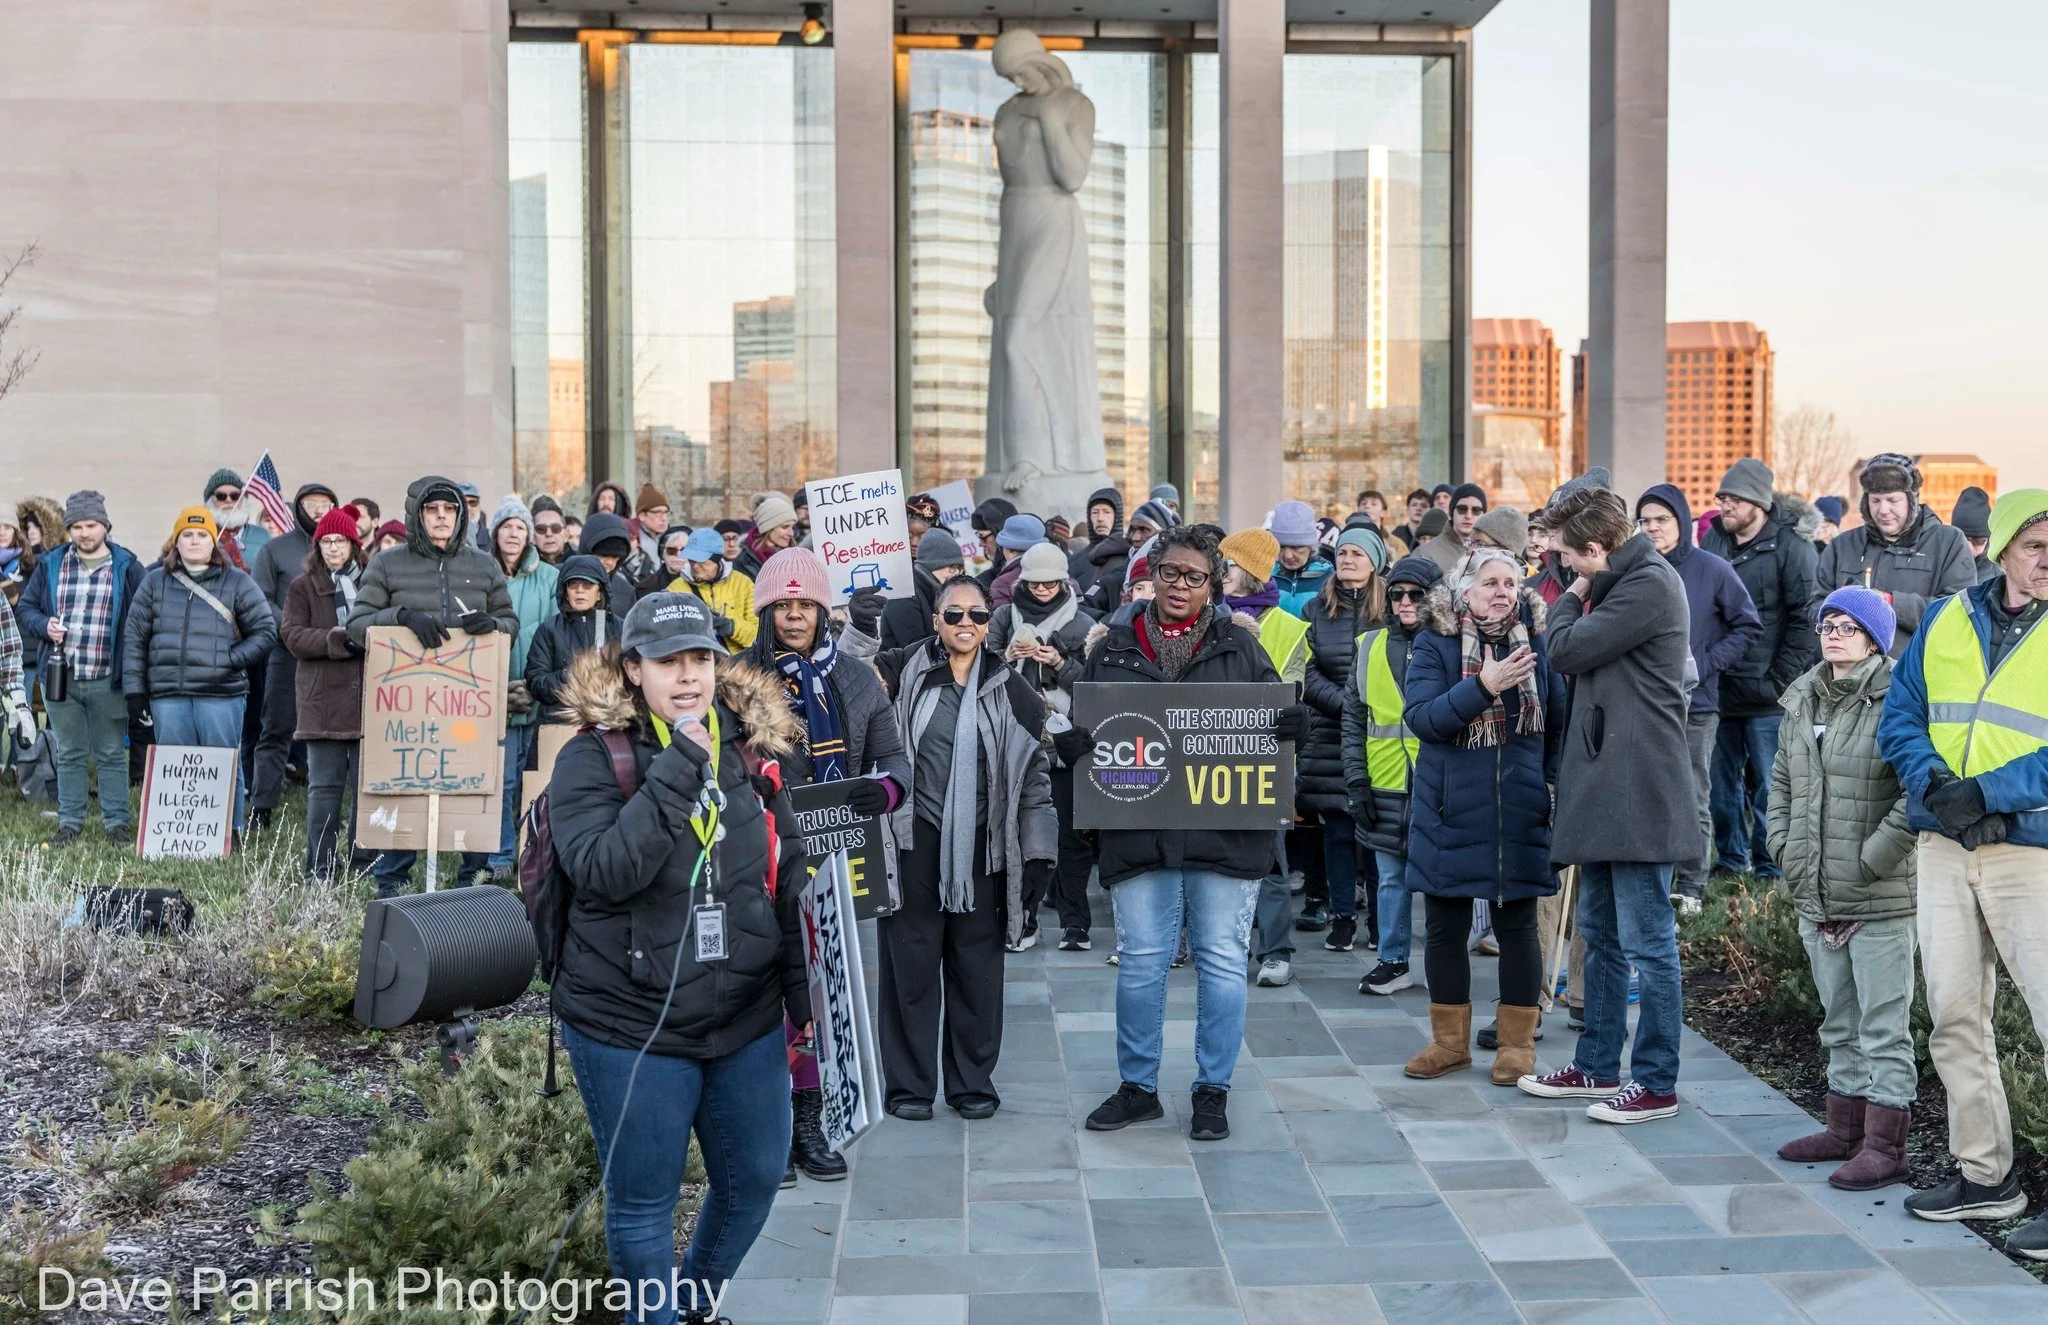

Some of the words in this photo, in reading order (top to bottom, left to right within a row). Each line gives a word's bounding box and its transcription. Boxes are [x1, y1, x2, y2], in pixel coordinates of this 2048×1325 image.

[814, 481, 858, 508] ICE
[860, 480, 897, 500] melts
[824, 507, 889, 535] UNDER
[821, 538, 906, 566] Resistance
[652, 611, 683, 624] WRONG
[683, 611, 705, 621] AGAIN
[655, 605, 678, 616] MAKE
[679, 604, 700, 613] LYING
[376, 685, 413, 713] NO
[1166, 708, 1198, 729] THE
[1201, 708, 1283, 730] STRUGGL
[384, 719, 440, 744] Melt
[1183, 734, 1279, 755] CONTINUES
[182, 753, 203, 766] NO
[390, 747, 458, 782] ICE
[163, 764, 218, 780] HUMAN
[1100, 771, 1159, 784] RICHMOND
[181, 779, 198, 792] IS
[1185, 765, 1276, 805] VOTE
[158, 792, 220, 809] ILLEGAL
[174, 808, 195, 821] ON
[152, 821, 219, 837] STOLEN
[161, 838, 206, 853] LAND
[803, 827, 865, 857] TINUES
[822, 870, 846, 999] THIS
[839, 1002, 855, 1067] IS
[848, 1070, 861, 1116] A
